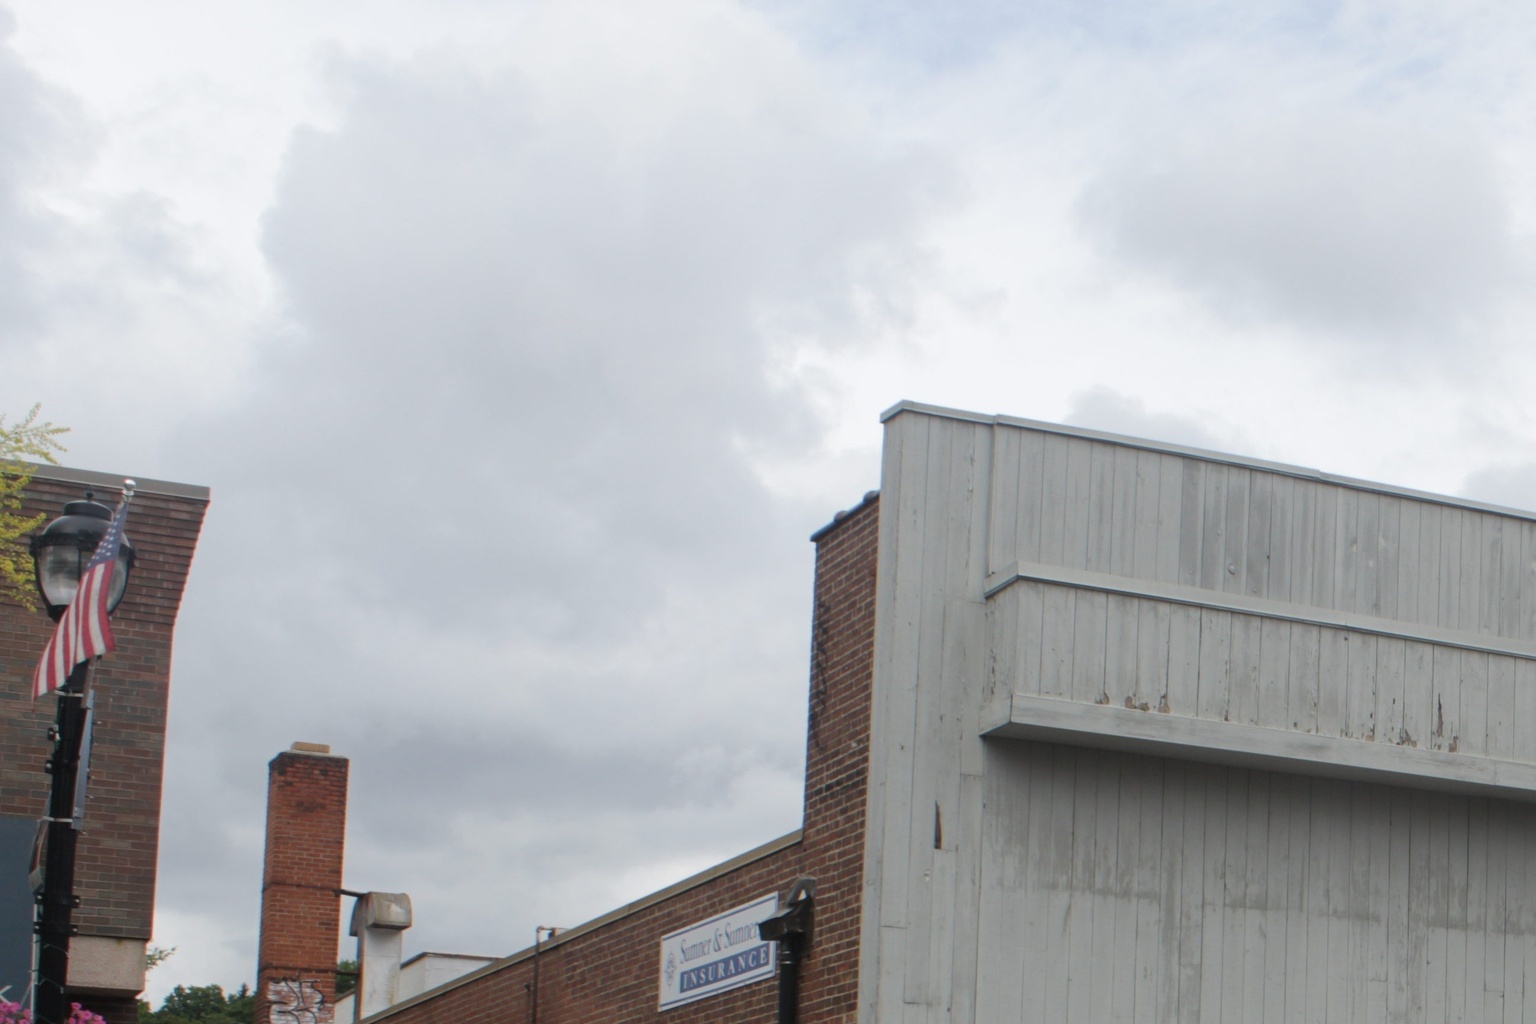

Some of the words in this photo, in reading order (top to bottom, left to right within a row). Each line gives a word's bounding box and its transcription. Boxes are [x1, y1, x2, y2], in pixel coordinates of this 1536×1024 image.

[679, 938, 711, 965] Sumner
[712, 928, 723, 953] &
[724, 922, 759, 950] Sumner
[682, 947, 769, 990] INSURANCE
